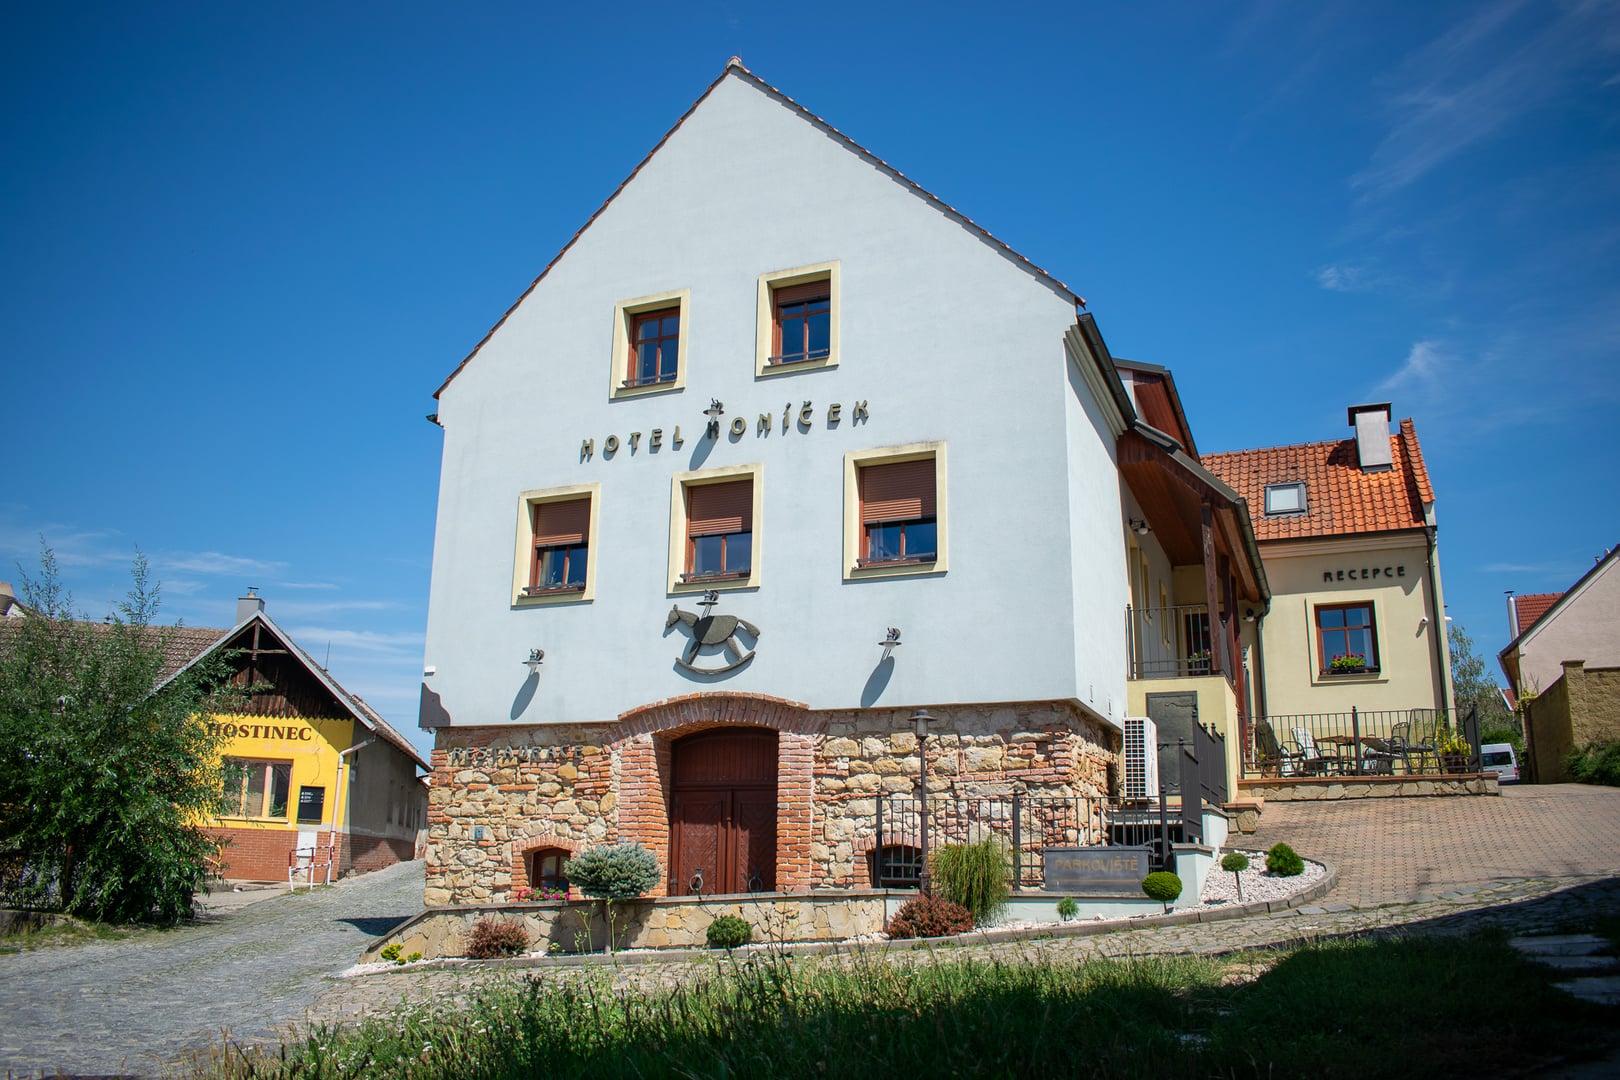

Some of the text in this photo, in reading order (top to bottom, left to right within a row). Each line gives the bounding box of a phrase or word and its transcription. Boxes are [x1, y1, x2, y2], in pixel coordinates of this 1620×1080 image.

[581, 400, 869, 457] HOTEL KONÍČEK
[1323, 566, 1405, 582] RECEPCE
[207, 723, 312, 741] HOSTINEC
[452, 745, 583, 761] RESTAURACE
[1054, 856, 1138, 872] PARKOVIŠTĚ
